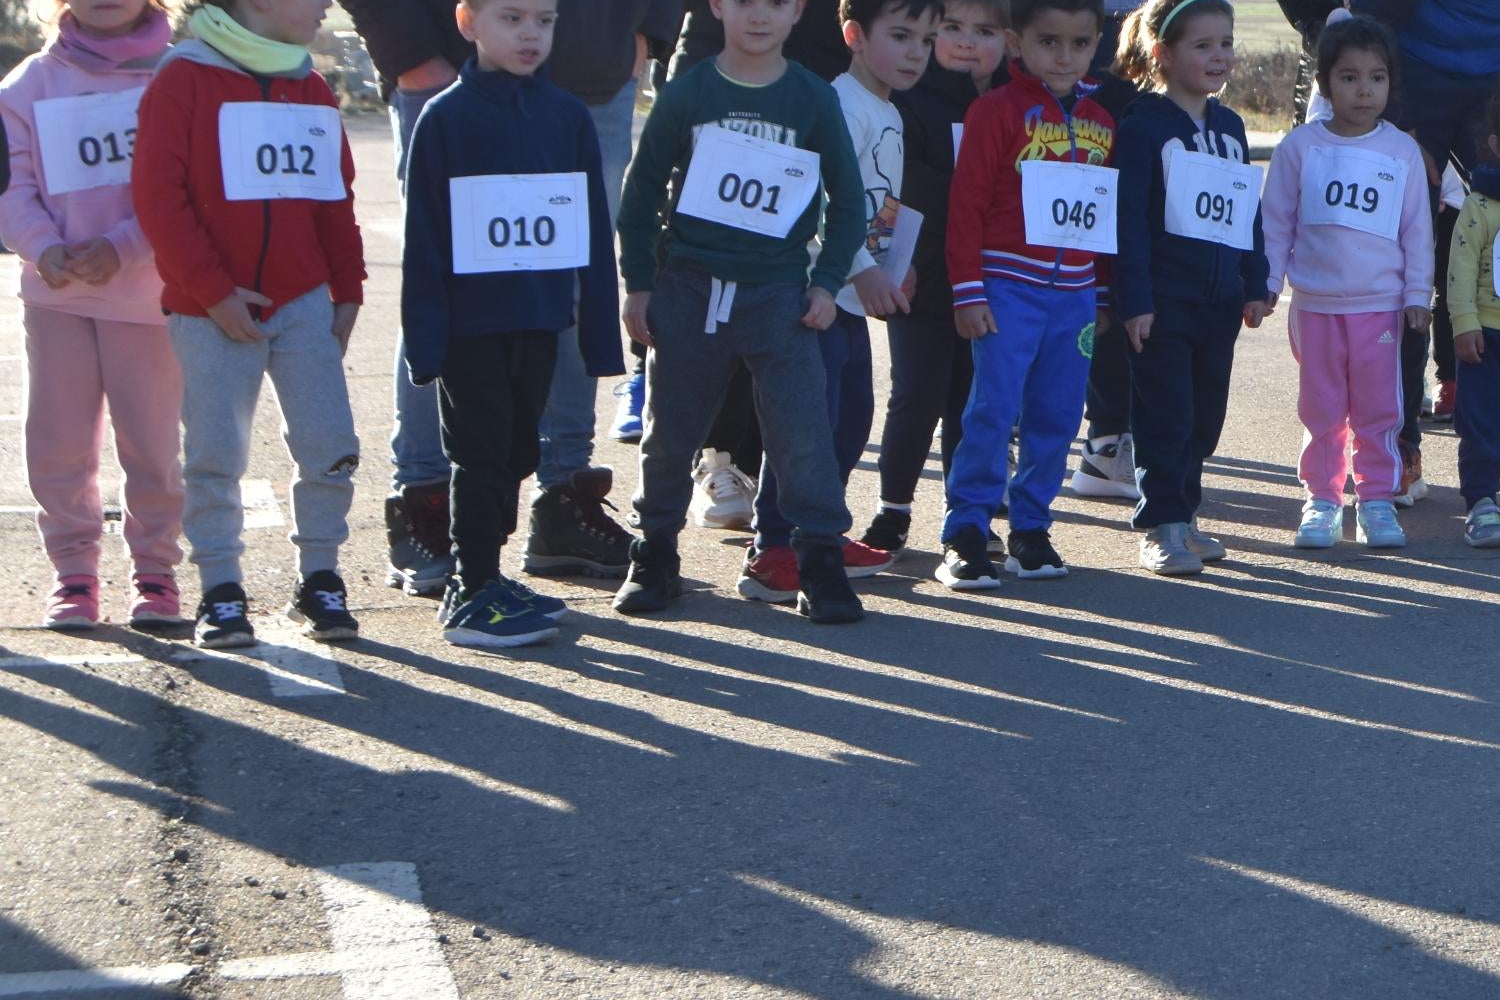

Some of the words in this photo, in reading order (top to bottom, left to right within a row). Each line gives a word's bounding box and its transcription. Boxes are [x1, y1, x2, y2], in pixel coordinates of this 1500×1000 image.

[256, 143, 317, 175] 012
[717, 172, 781, 215] 001
[1195, 191, 1233, 226] 091
[1325, 180, 1379, 213] 019
[1051, 198, 1097, 230] 046
[488, 215, 556, 248] 010
